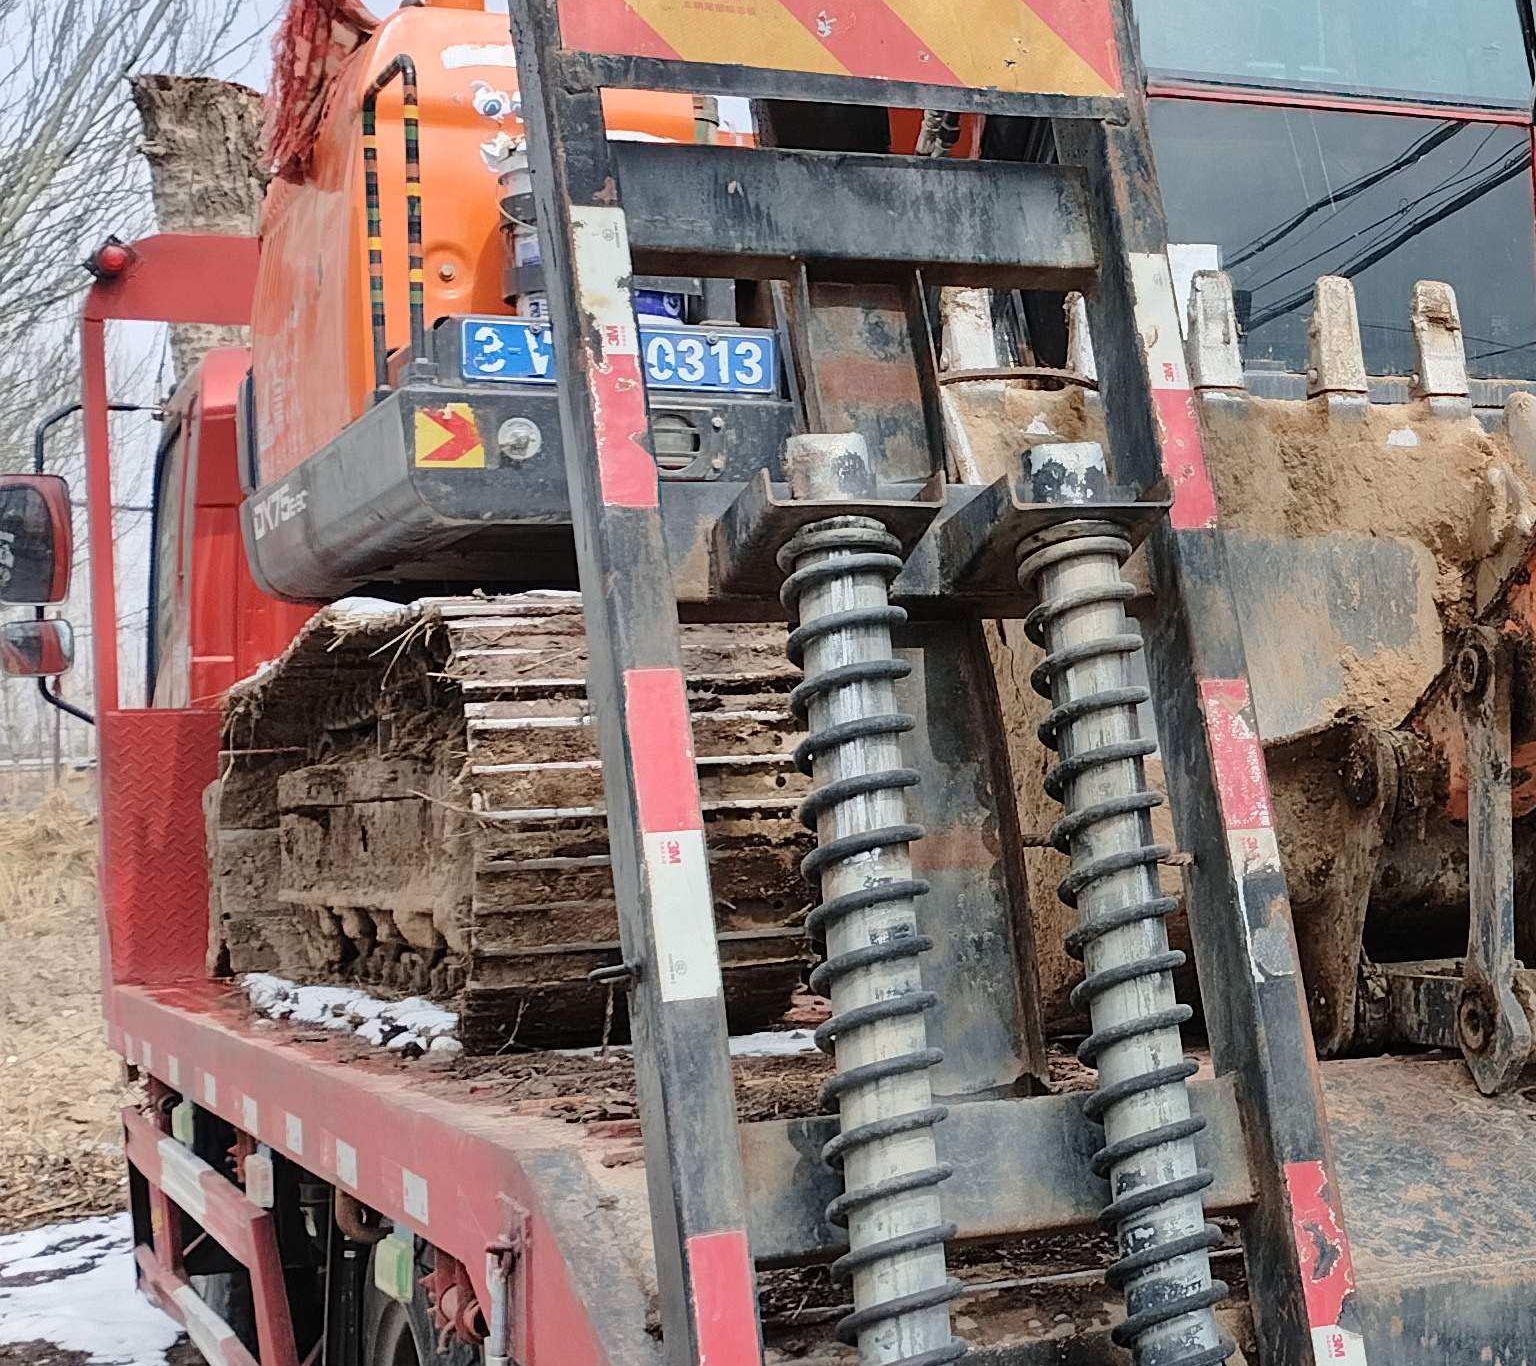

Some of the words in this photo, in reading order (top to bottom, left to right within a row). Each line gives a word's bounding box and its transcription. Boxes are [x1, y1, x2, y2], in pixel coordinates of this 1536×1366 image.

[606, 325, 620, 346] 3M
[647, 336, 763, 385] 0313
[667, 840, 682, 864] 3M
[1332, 1333, 1345, 1358] 3M
